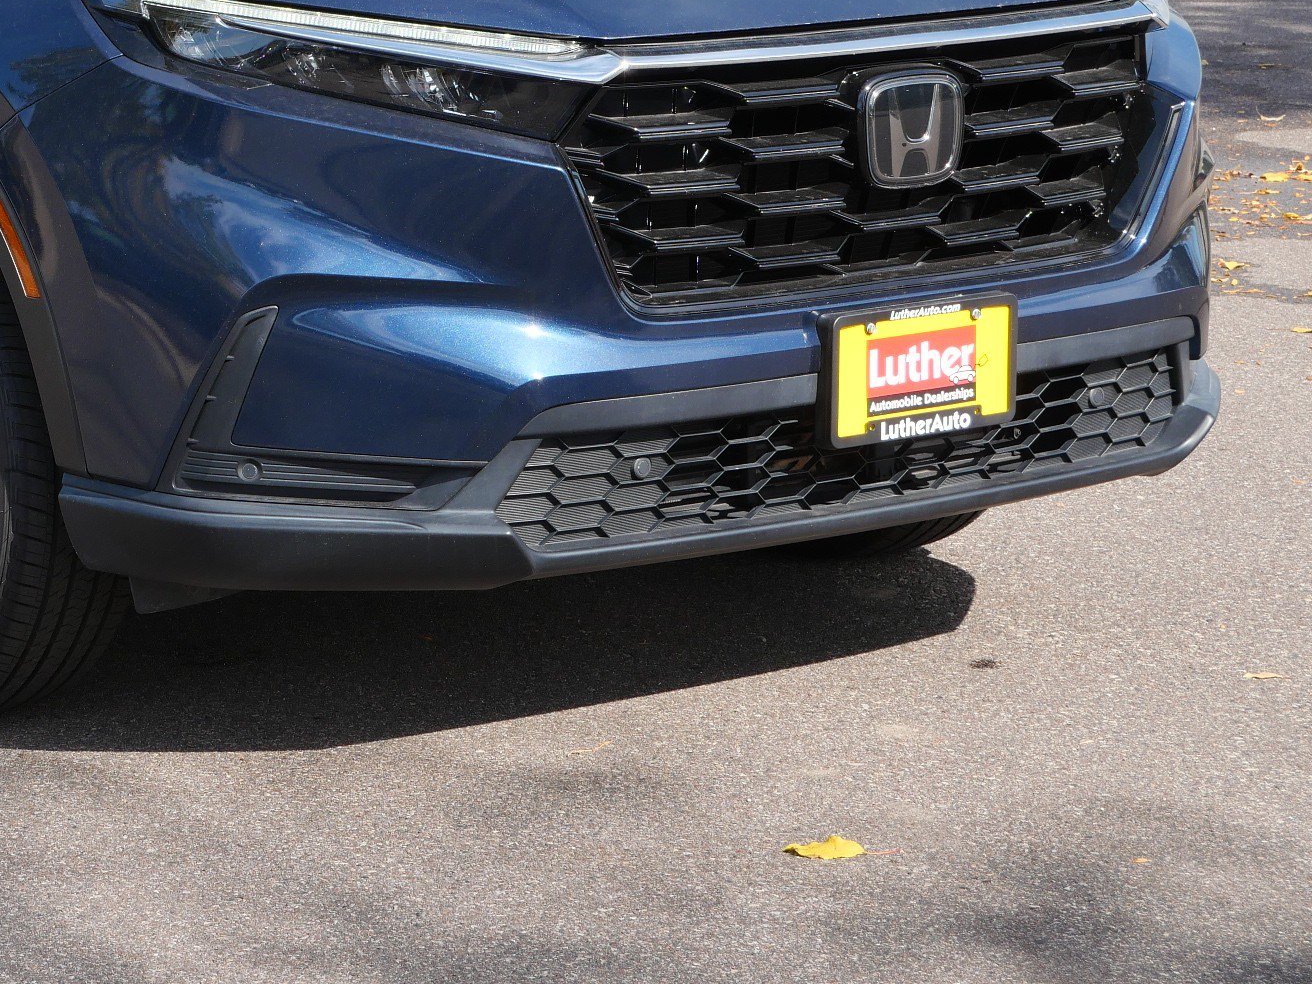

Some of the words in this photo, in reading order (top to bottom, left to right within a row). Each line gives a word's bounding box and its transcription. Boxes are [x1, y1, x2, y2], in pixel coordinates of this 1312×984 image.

[890, 303, 961, 321] LutherAuto.com
[868, 341, 975, 389] Luther
[869, 394, 923, 413] Automobile
[924, 387, 974, 405] Dealerships
[880, 411, 971, 441] LutherAuto
